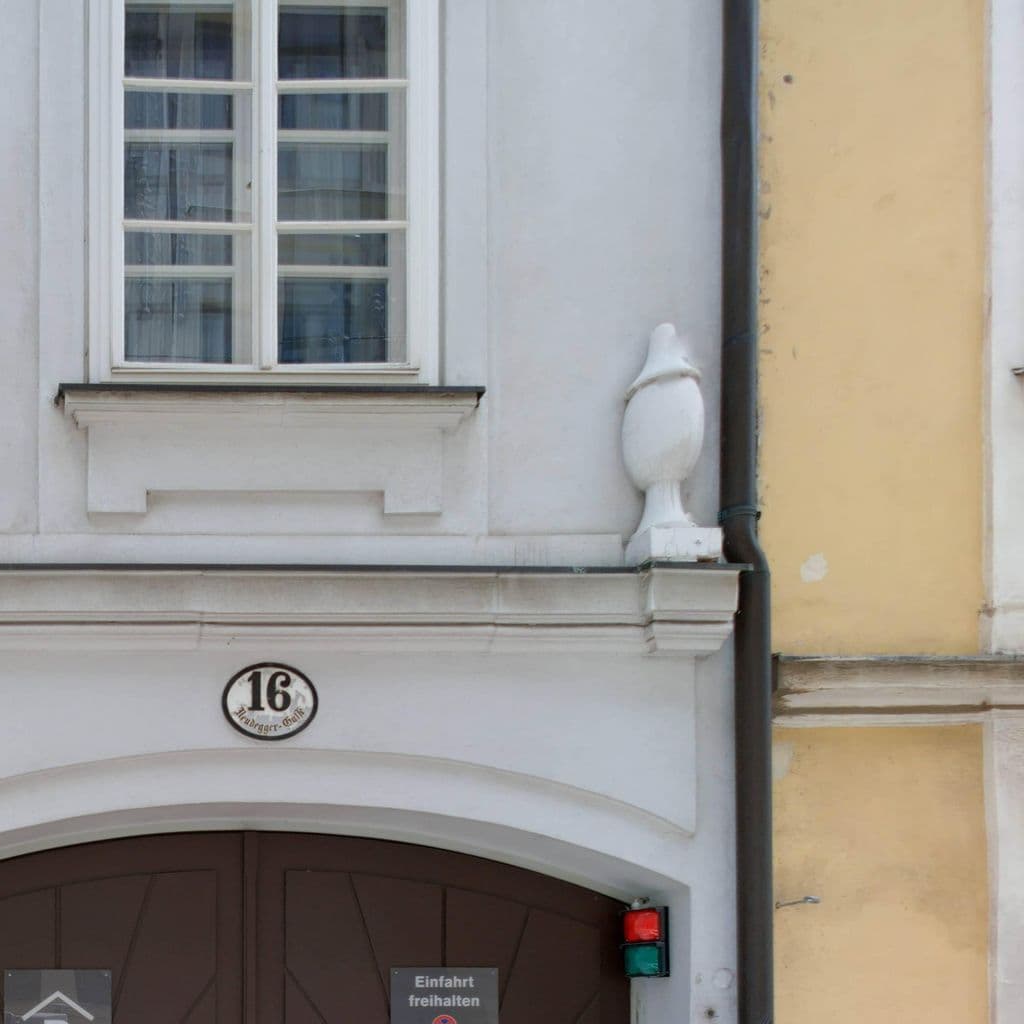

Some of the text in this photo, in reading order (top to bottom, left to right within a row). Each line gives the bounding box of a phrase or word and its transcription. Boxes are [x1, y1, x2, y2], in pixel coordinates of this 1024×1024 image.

[247, 671, 291, 712] 16
[414, 976, 474, 988] Einfahrt
[408, 995, 480, 1007] freihalten
